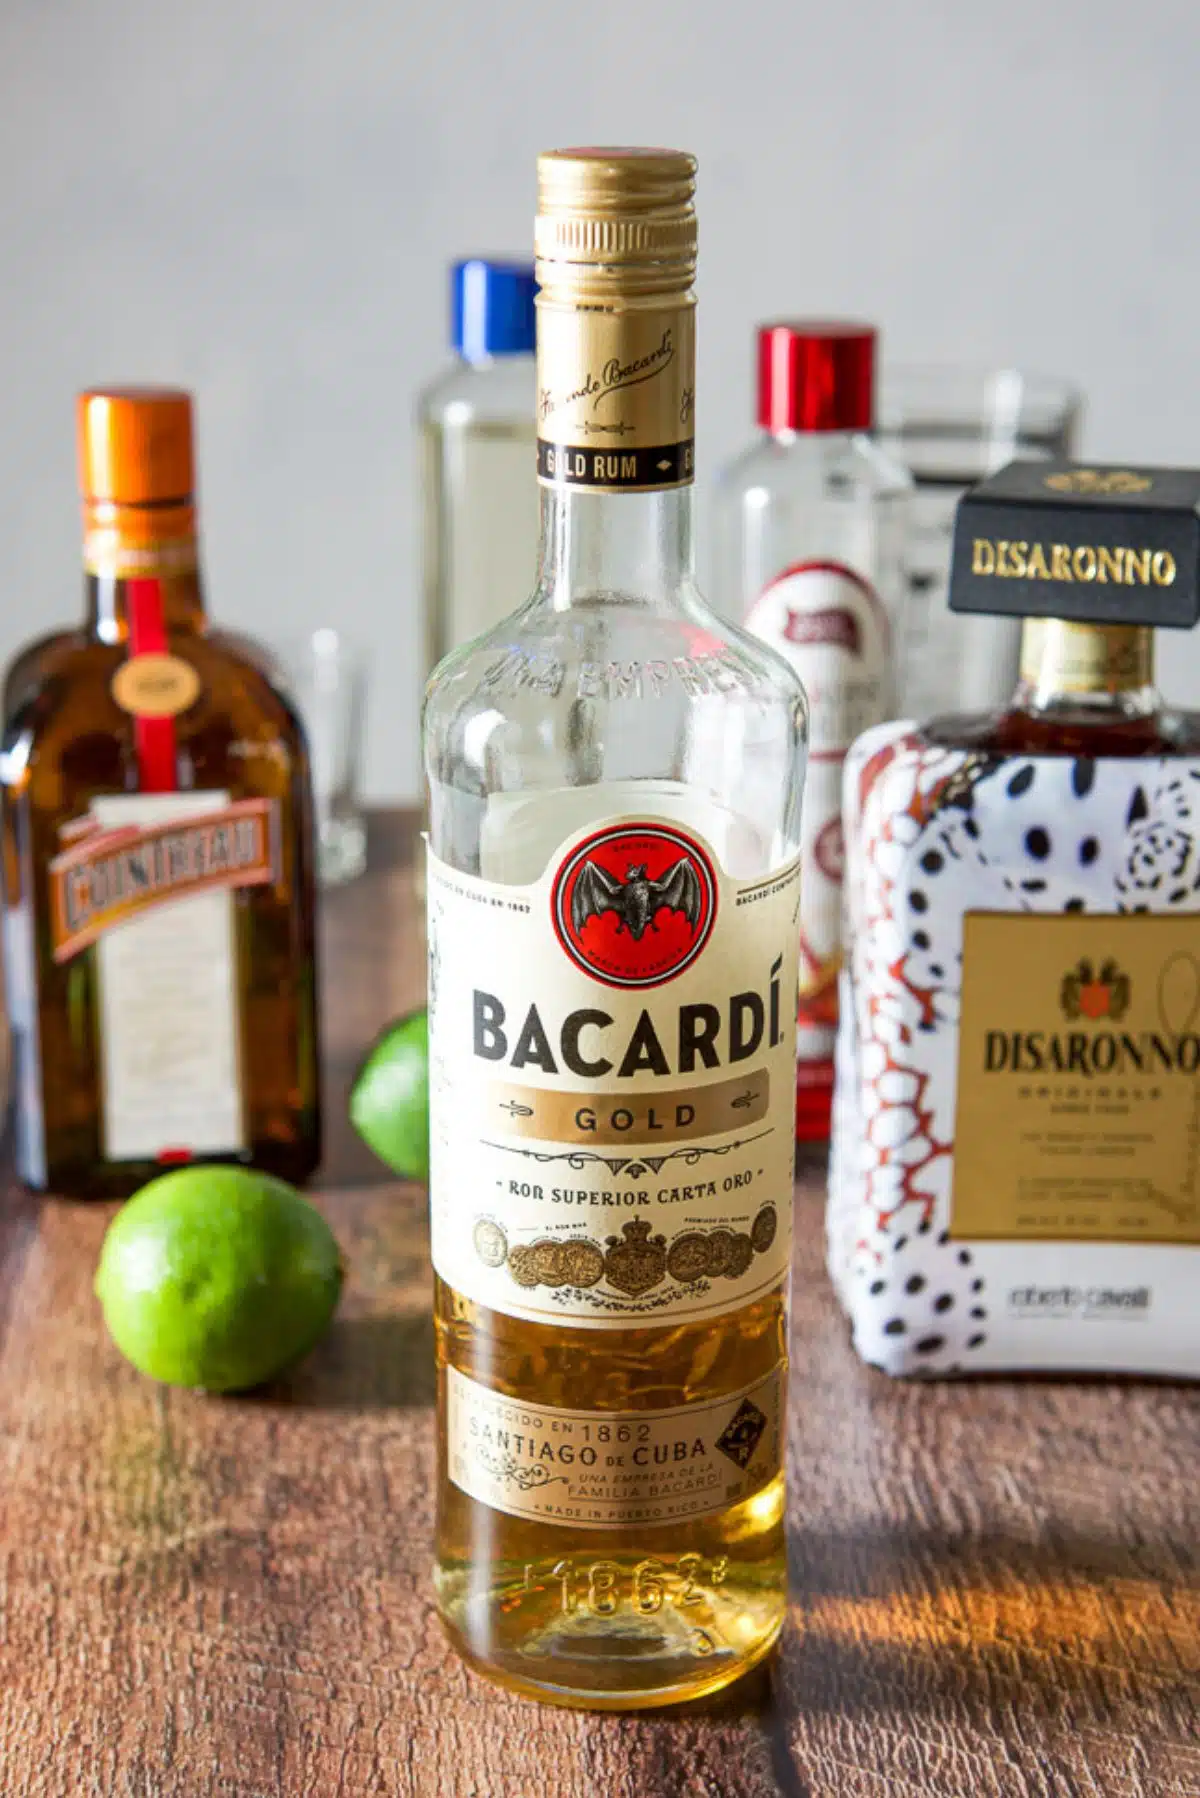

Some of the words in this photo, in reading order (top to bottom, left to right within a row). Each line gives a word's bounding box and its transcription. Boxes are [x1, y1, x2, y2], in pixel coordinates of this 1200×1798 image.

[547, 449, 586, 477] GLD
[593, 455, 637, 479] RUM
[971, 537, 1177, 586] DISARONNO
[473, 952, 781, 1078] BACARDÍ
[984, 1029, 1200, 1080] DISARONNO
[575, 1104, 697, 1132] GOLD
[508, 1180, 544, 1200] RON
[551, 1187, 651, 1206] SUPERIOR
[657, 1181, 717, 1204] CARTA
[722, 1168, 754, 1192] ORO
[470, 1416, 598, 1467] SANTIAGO
[605, 1455, 625, 1468] DE
[632, 1437, 707, 1467] CUBA
[551, 1420, 573, 1434] EN
[581, 1424, 651, 1443] 1862
[568, 1485, 641, 1499] FAMILIA
[545, 1504, 581, 1518] MADE
[588, 1510, 602, 1519] IN
